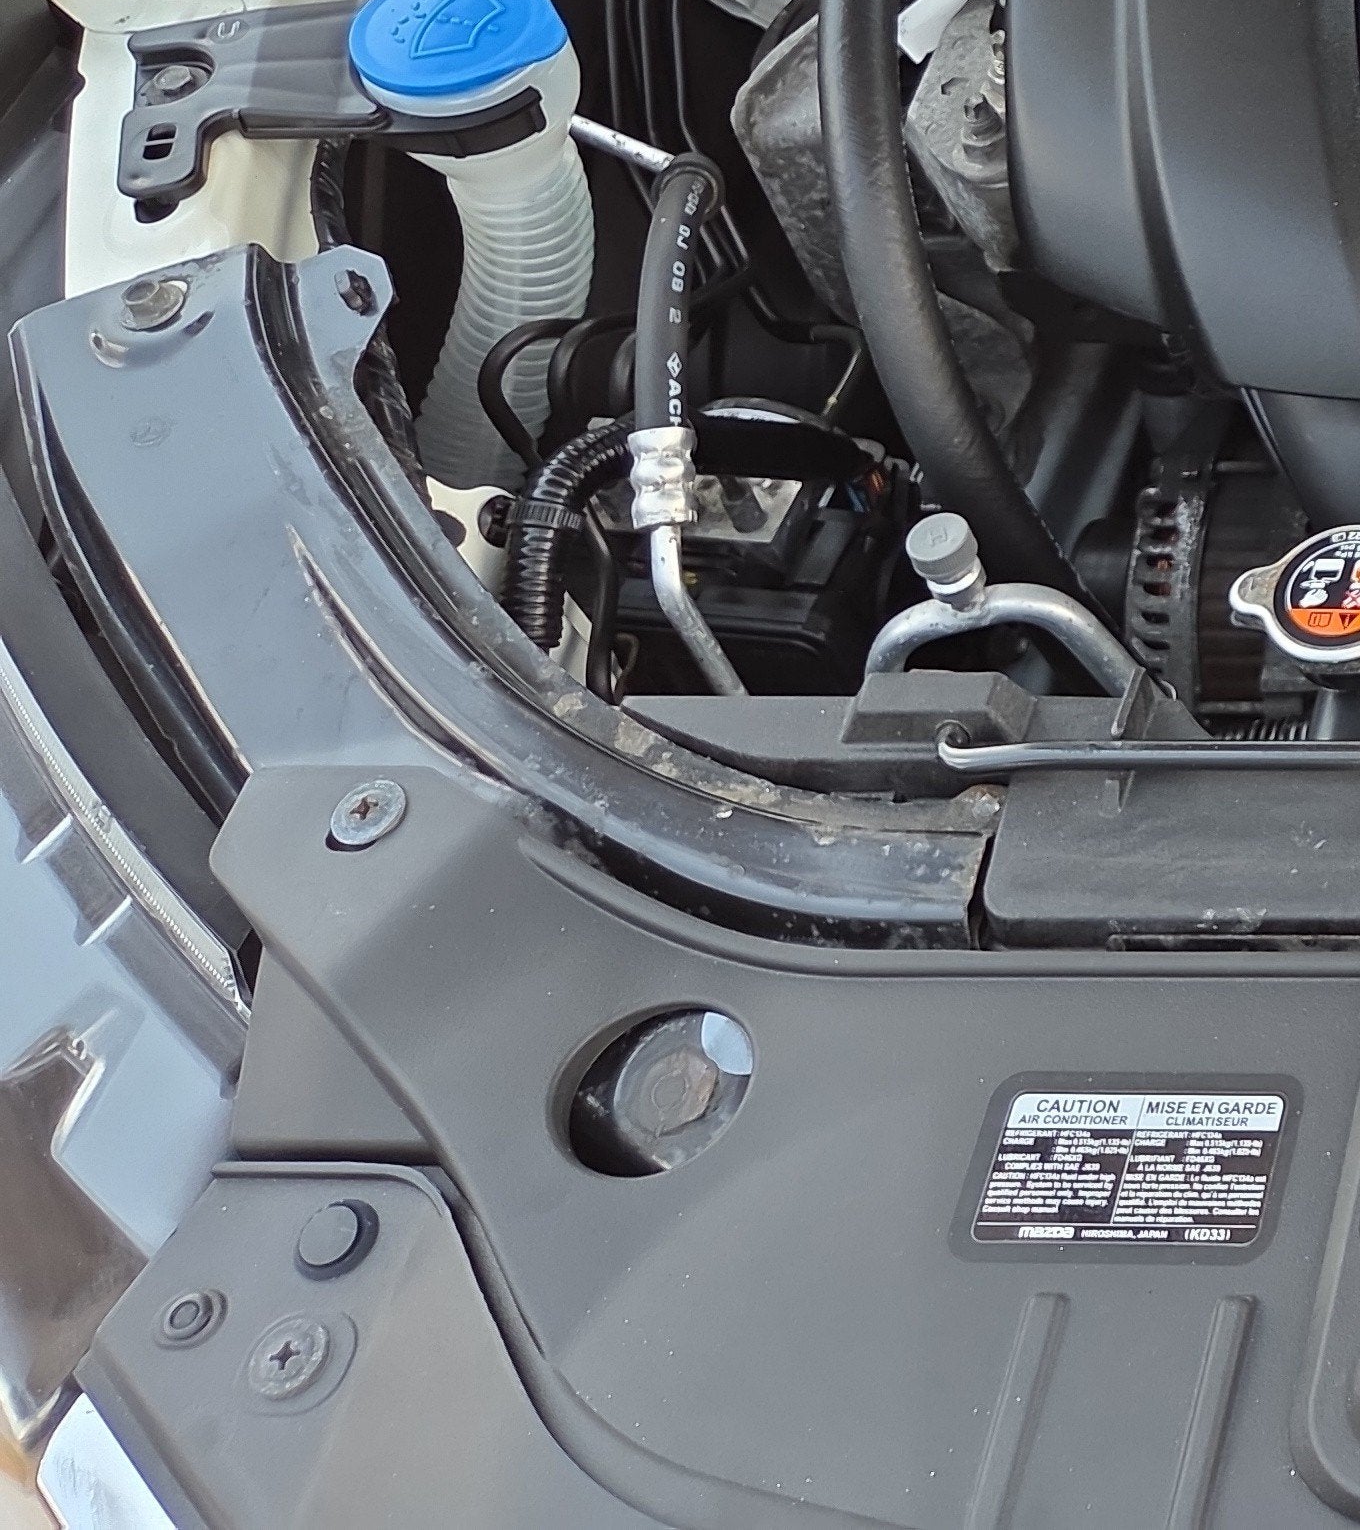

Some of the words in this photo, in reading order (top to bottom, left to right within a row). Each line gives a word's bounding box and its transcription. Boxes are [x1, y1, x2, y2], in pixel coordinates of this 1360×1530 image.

[1037, 1100, 1120, 1113] CAUTION
[1146, 1102, 1188, 1114] MISE
[1191, 1102, 1215, 1114] EN
[1218, 1102, 1278, 1115] GARDE
[1018, 1115, 1039, 1124] AIR
[1043, 1115, 1128, 1125] CONDITIONER
[1165, 1117, 1248, 1126] CLIMATISEUR
[1184, 1228, 1231, 1241] (KD33)
